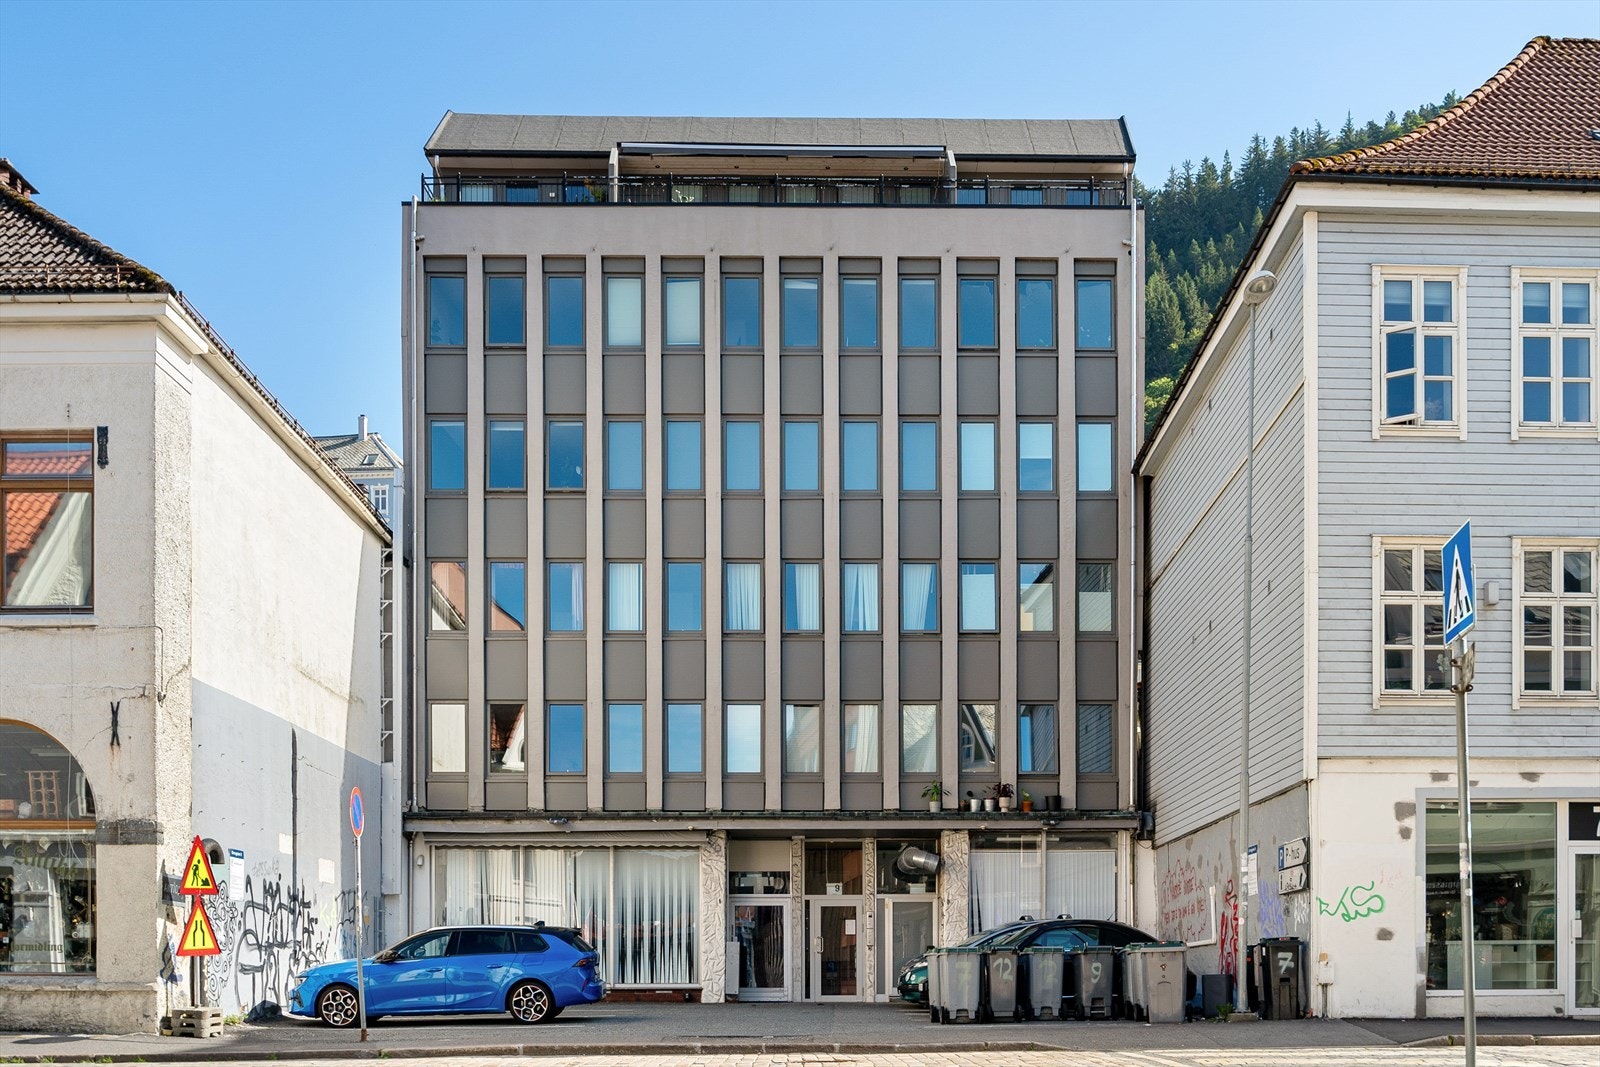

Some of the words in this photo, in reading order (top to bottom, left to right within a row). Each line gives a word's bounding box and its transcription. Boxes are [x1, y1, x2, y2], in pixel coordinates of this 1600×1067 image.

[834, 884, 840, 893] 9
[992, 957, 1014, 982] 12
[1090, 962, 1102, 984] 9
[1277, 951, 1295, 975] 7
